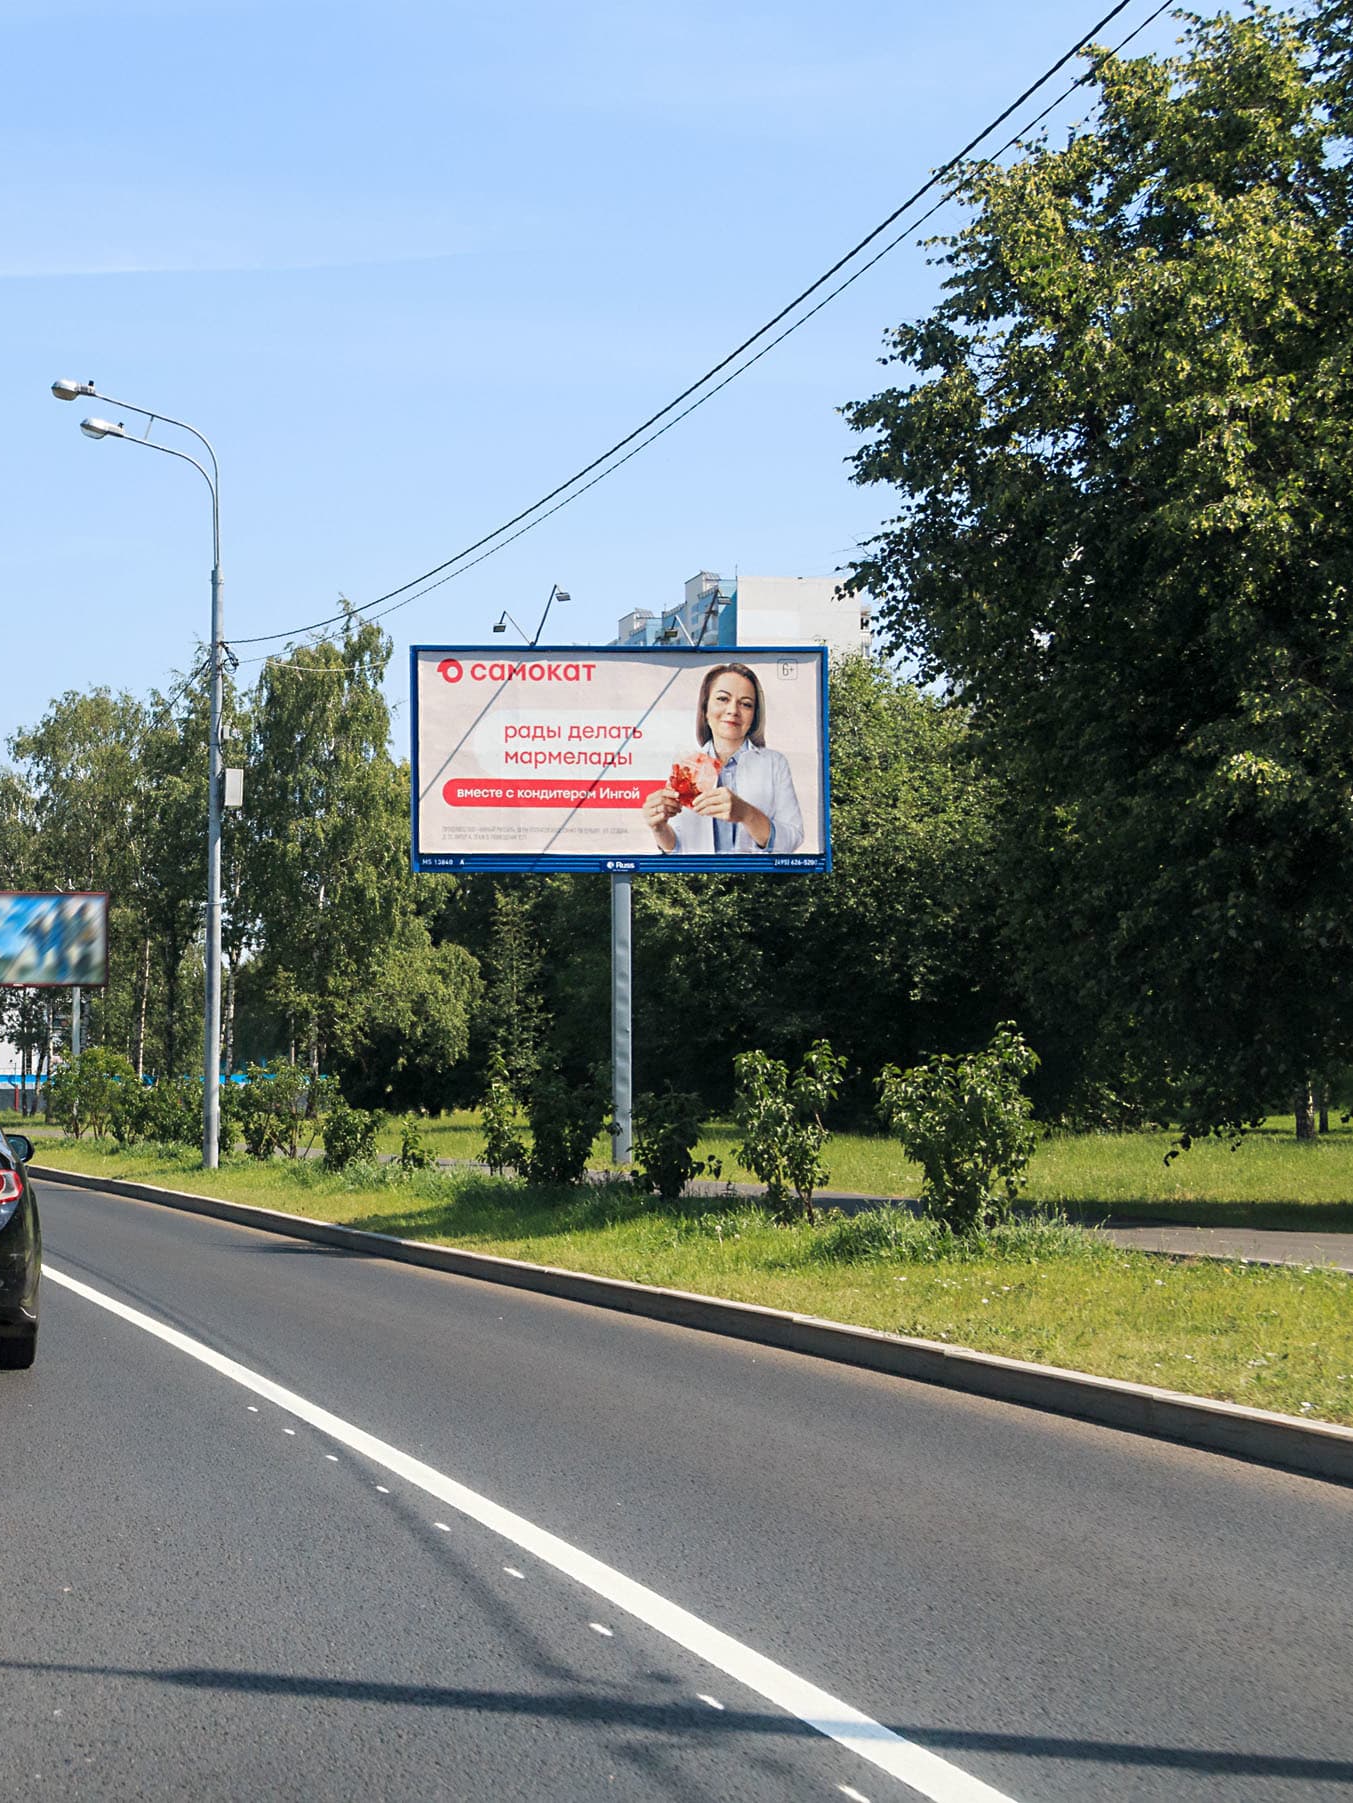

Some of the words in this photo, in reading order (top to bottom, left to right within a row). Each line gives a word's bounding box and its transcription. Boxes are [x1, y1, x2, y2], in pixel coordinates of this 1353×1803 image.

[470, 663, 597, 681] самокат
[782, 662, 795, 677] 6+
[504, 725, 561, 743] рады
[567, 725, 643, 742] делать
[504, 751, 633, 769] мармелады
[456, 787, 503, 798] вместе
[505, 788, 514, 798] с
[517, 788, 596, 801] кондитером
[599, 787, 640, 800] Ингой
